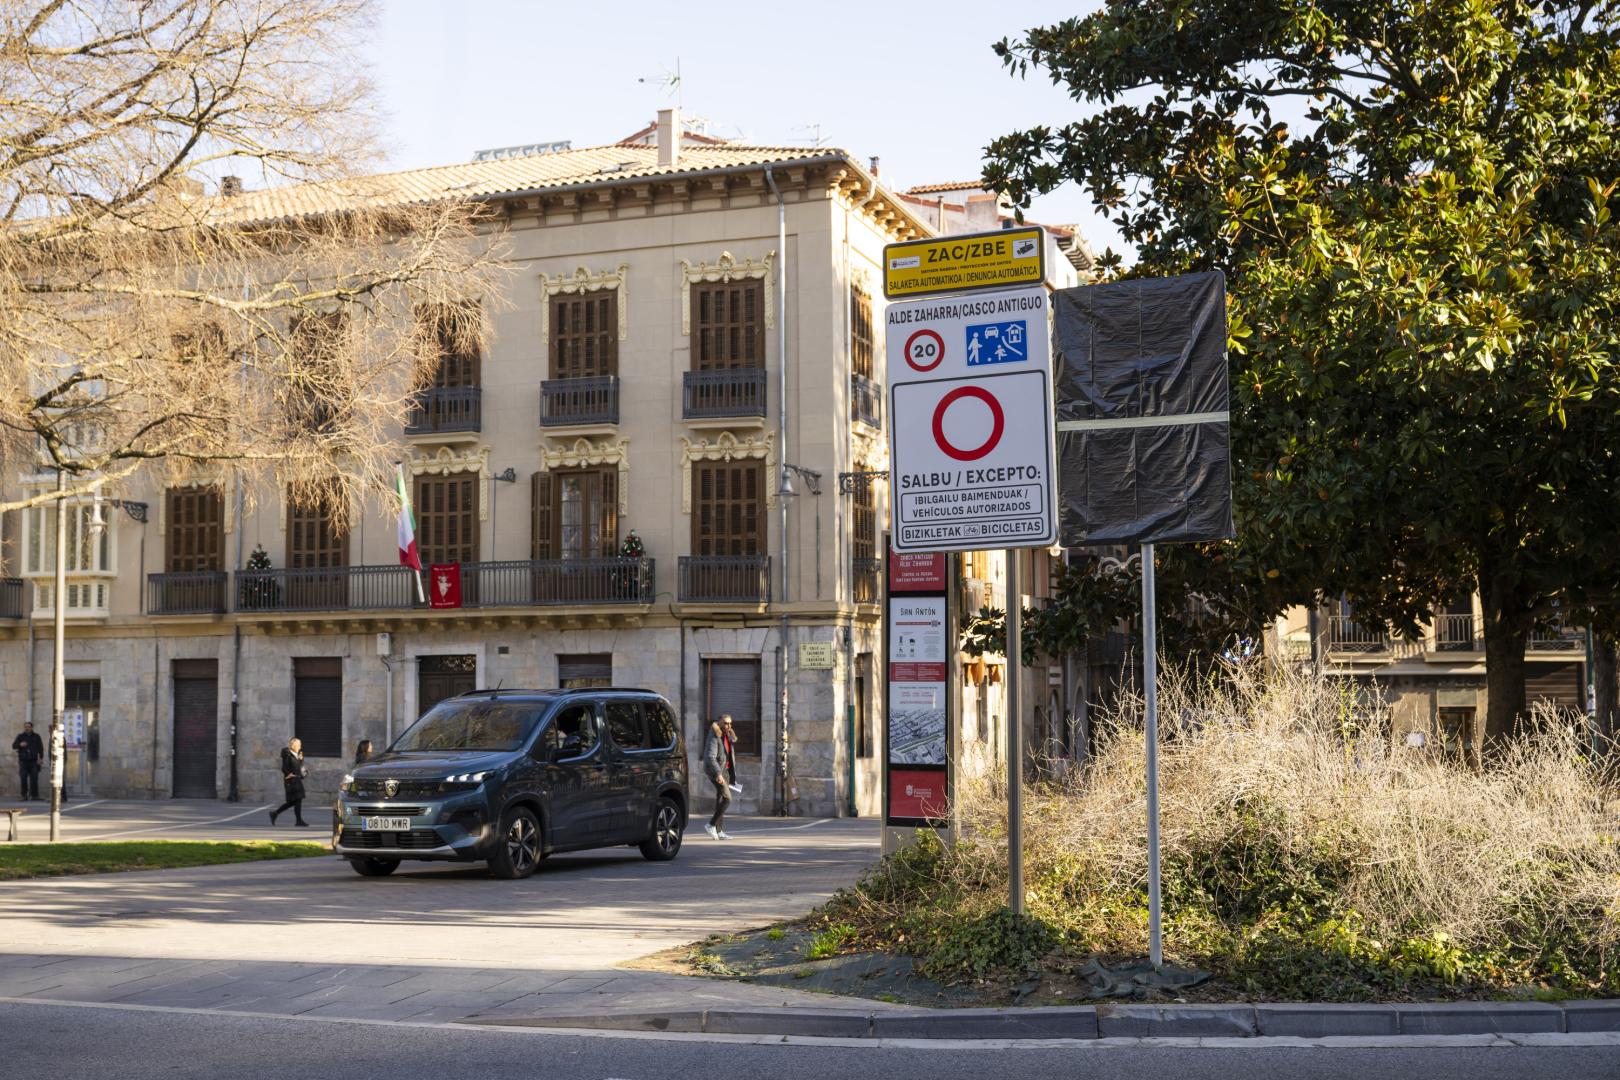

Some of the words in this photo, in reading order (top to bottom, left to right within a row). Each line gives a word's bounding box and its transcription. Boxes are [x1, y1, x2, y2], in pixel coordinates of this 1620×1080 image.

[928, 241, 1005, 263] ZAC/ZBE
[889, 278, 920, 290] SALAKETA
[920, 274, 962, 287] AUTOMATIKOA
[966, 270, 998, 282] DENUNCIA
[998, 266, 1038, 278] AUTOMÁTICA
[889, 310, 912, 324] ALDE
[914, 300, 995, 322] ZAHARRA/CASCO
[998, 296, 1042, 312] ANTIGUO
[914, 344, 936, 358] 20
[902, 472, 950, 488] SALBU
[956, 471, 962, 487] /
[966, 465, 1041, 484] EXCEPTO:
[915, 494, 958, 505] IBILGAILU
[962, 489, 1022, 502] BAIMENDUAK
[912, 506, 964, 518] VEHÍCULOS
[966, 502, 1031, 514] AUTORIZADOS
[905, 526, 961, 539] BIZIKLETAK
[981, 522, 1040, 535] BICICLETAS
[368, 819, 389, 828] 0810
